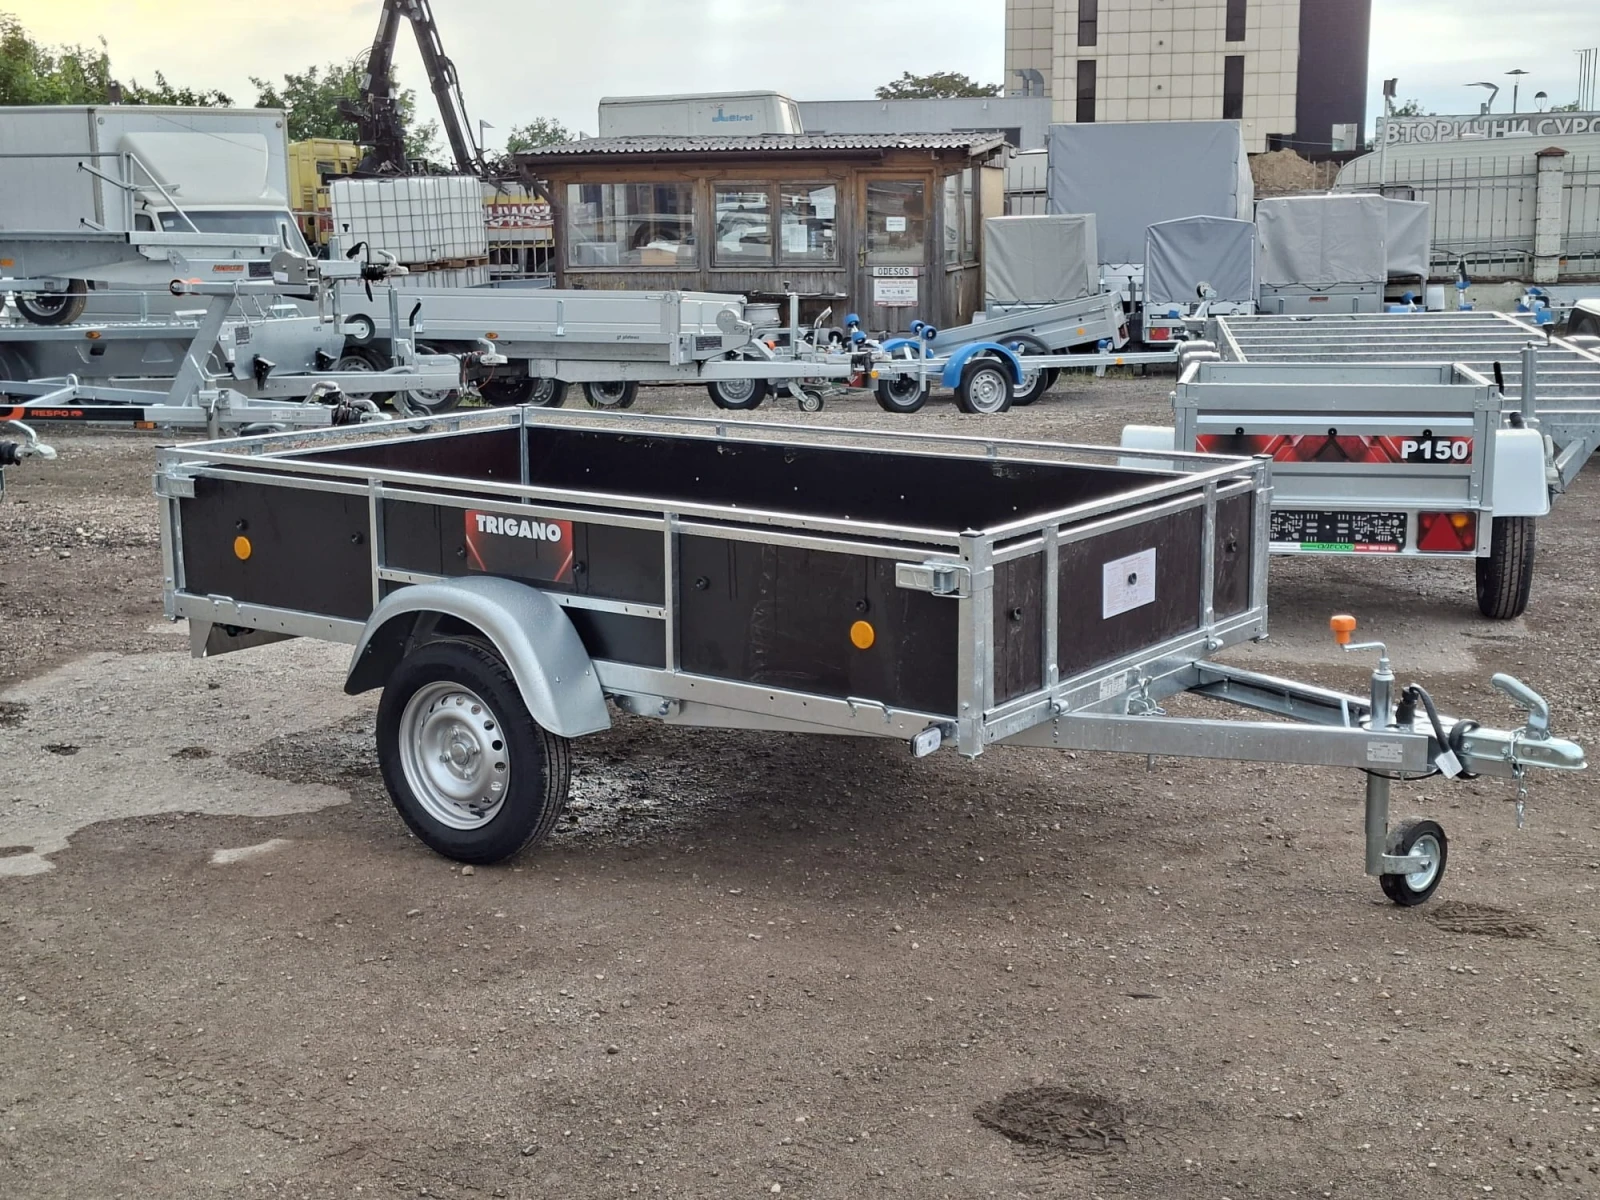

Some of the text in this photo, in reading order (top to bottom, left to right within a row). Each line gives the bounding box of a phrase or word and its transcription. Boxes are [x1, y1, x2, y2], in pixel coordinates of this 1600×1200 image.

[877, 267, 910, 276] ODESOS
[1401, 440, 1468, 460] P150
[475, 514, 561, 542] TRIGANO
